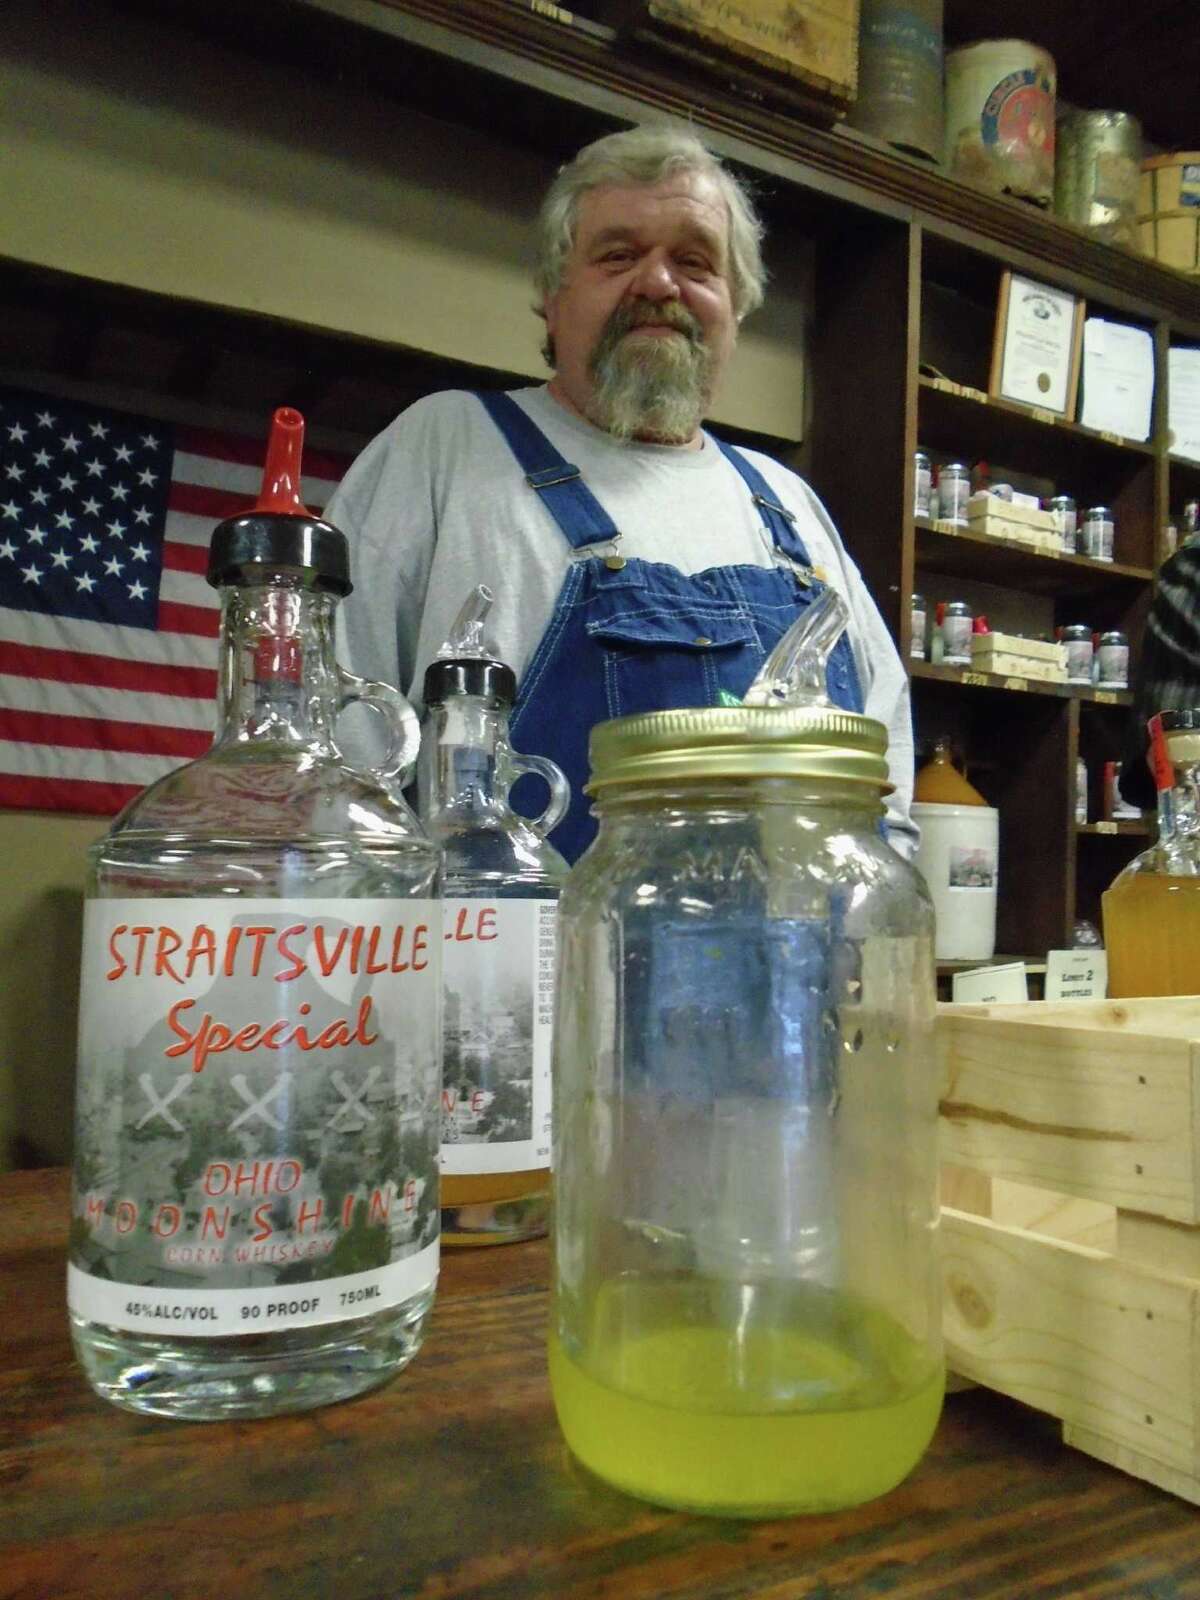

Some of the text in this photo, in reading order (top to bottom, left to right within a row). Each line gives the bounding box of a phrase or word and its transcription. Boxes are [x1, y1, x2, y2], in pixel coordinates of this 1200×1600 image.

[106, 924, 430, 985] STRAITSVILLE
[1086, 969, 1095, 982] 2
[164, 995, 379, 1073] Special
[203, 1159, 302, 1197] OHIO
[87, 1179, 418, 1243] MOONSHINE
[165, 1237, 335, 1265] CORN WHISKEY
[240, 1304, 261, 1320] 90
[266, 1298, 321, 1318] PROOF
[339, 1284, 382, 1305] 750ML
